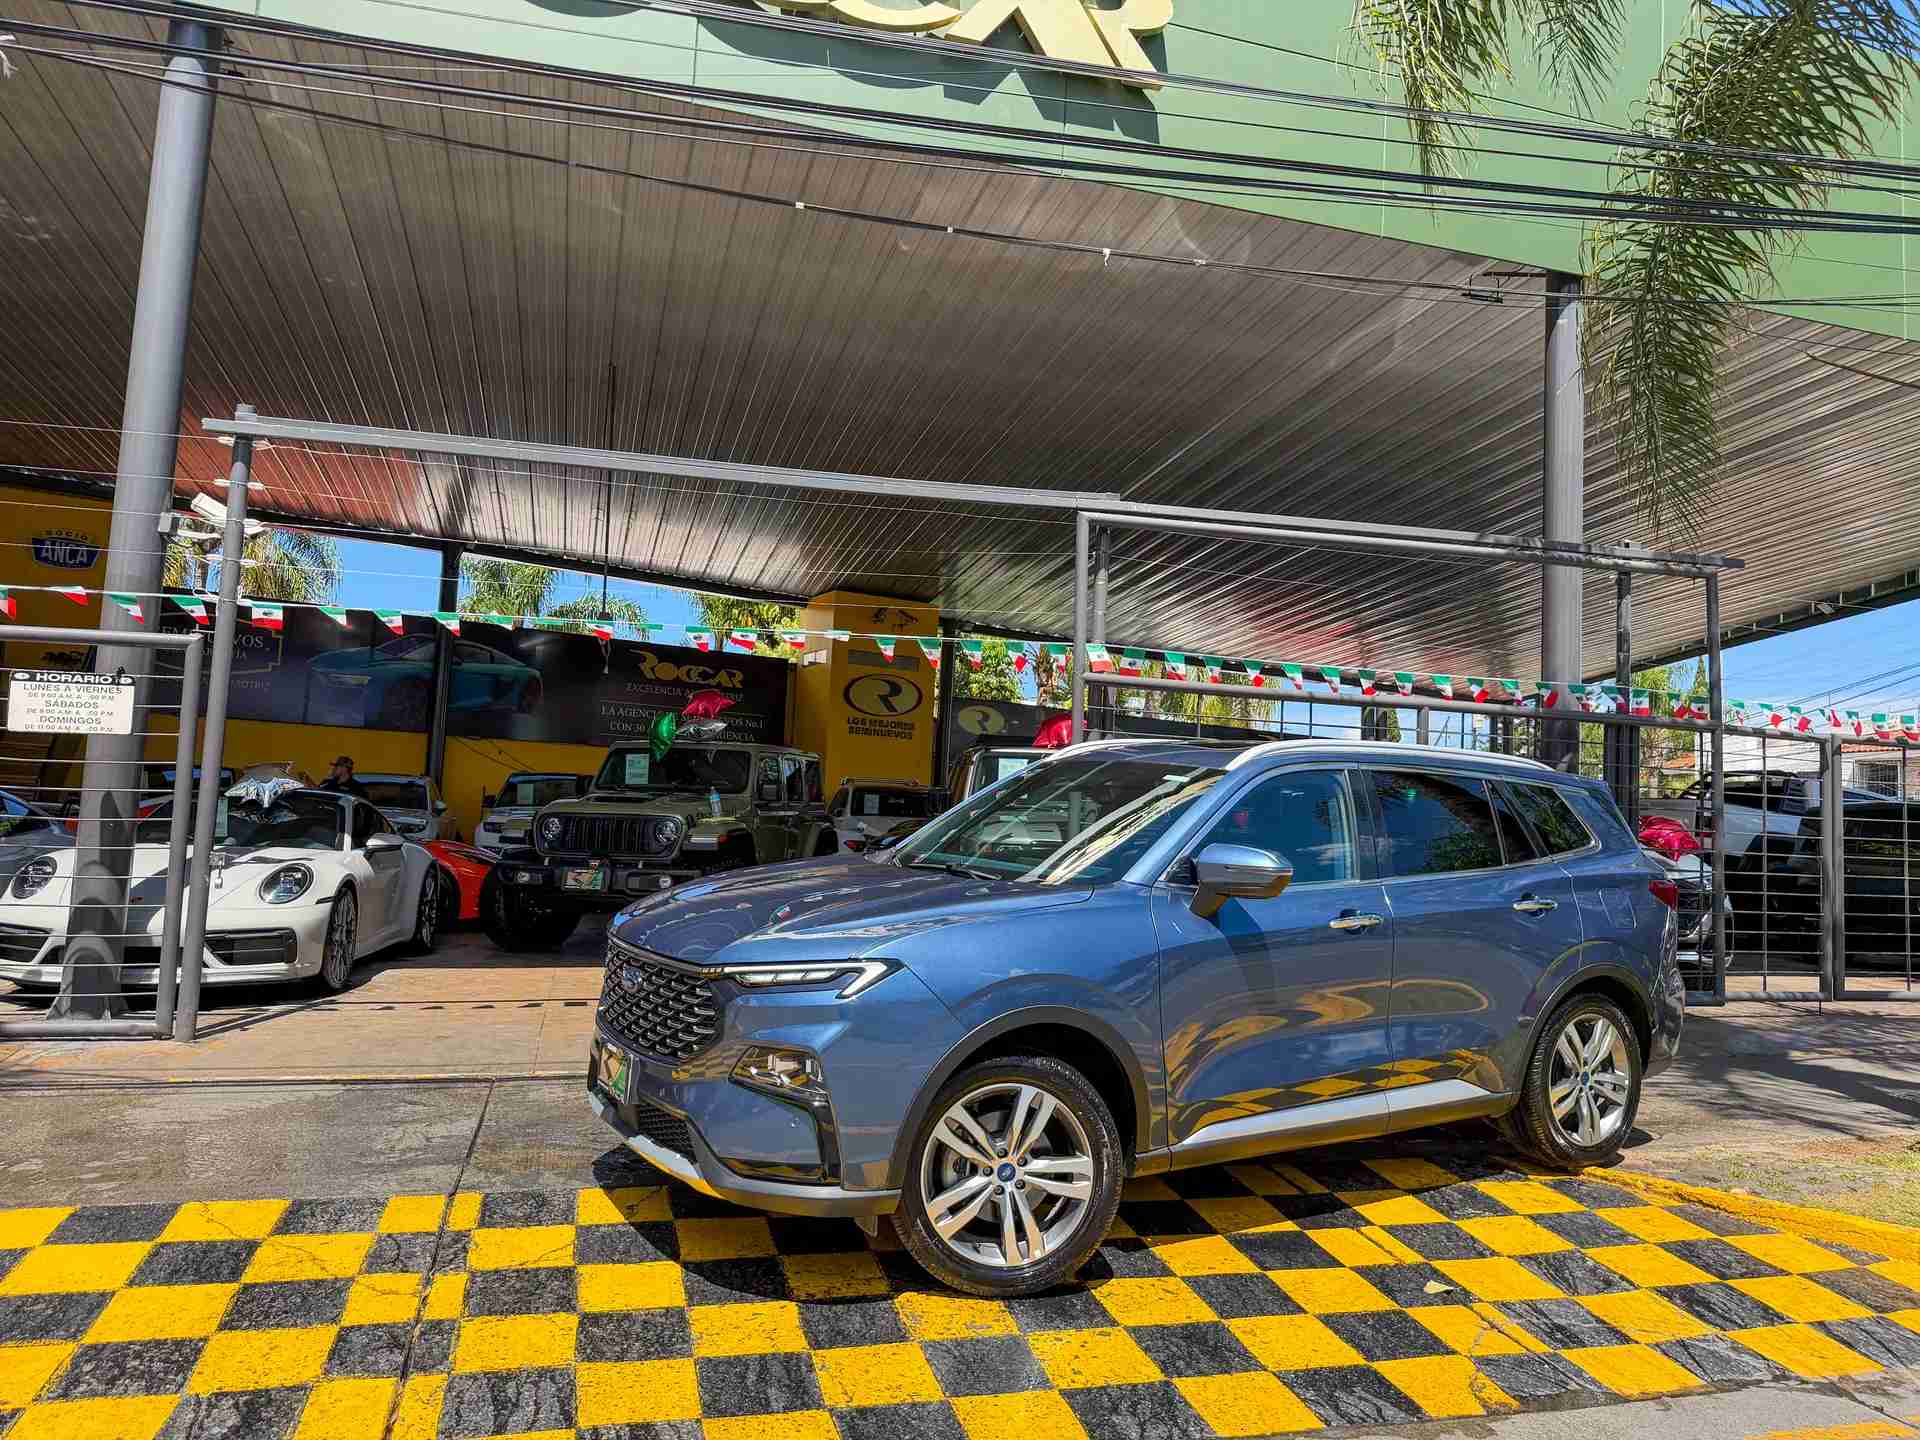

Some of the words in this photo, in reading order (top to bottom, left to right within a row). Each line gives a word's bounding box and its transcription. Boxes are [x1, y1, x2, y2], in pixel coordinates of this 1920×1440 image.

[40, 542, 88, 564] ANCA
[36, 672, 113, 685] HORARIO
[24, 683, 60, 692] LUNES
[76, 685, 122, 695] VIERNES
